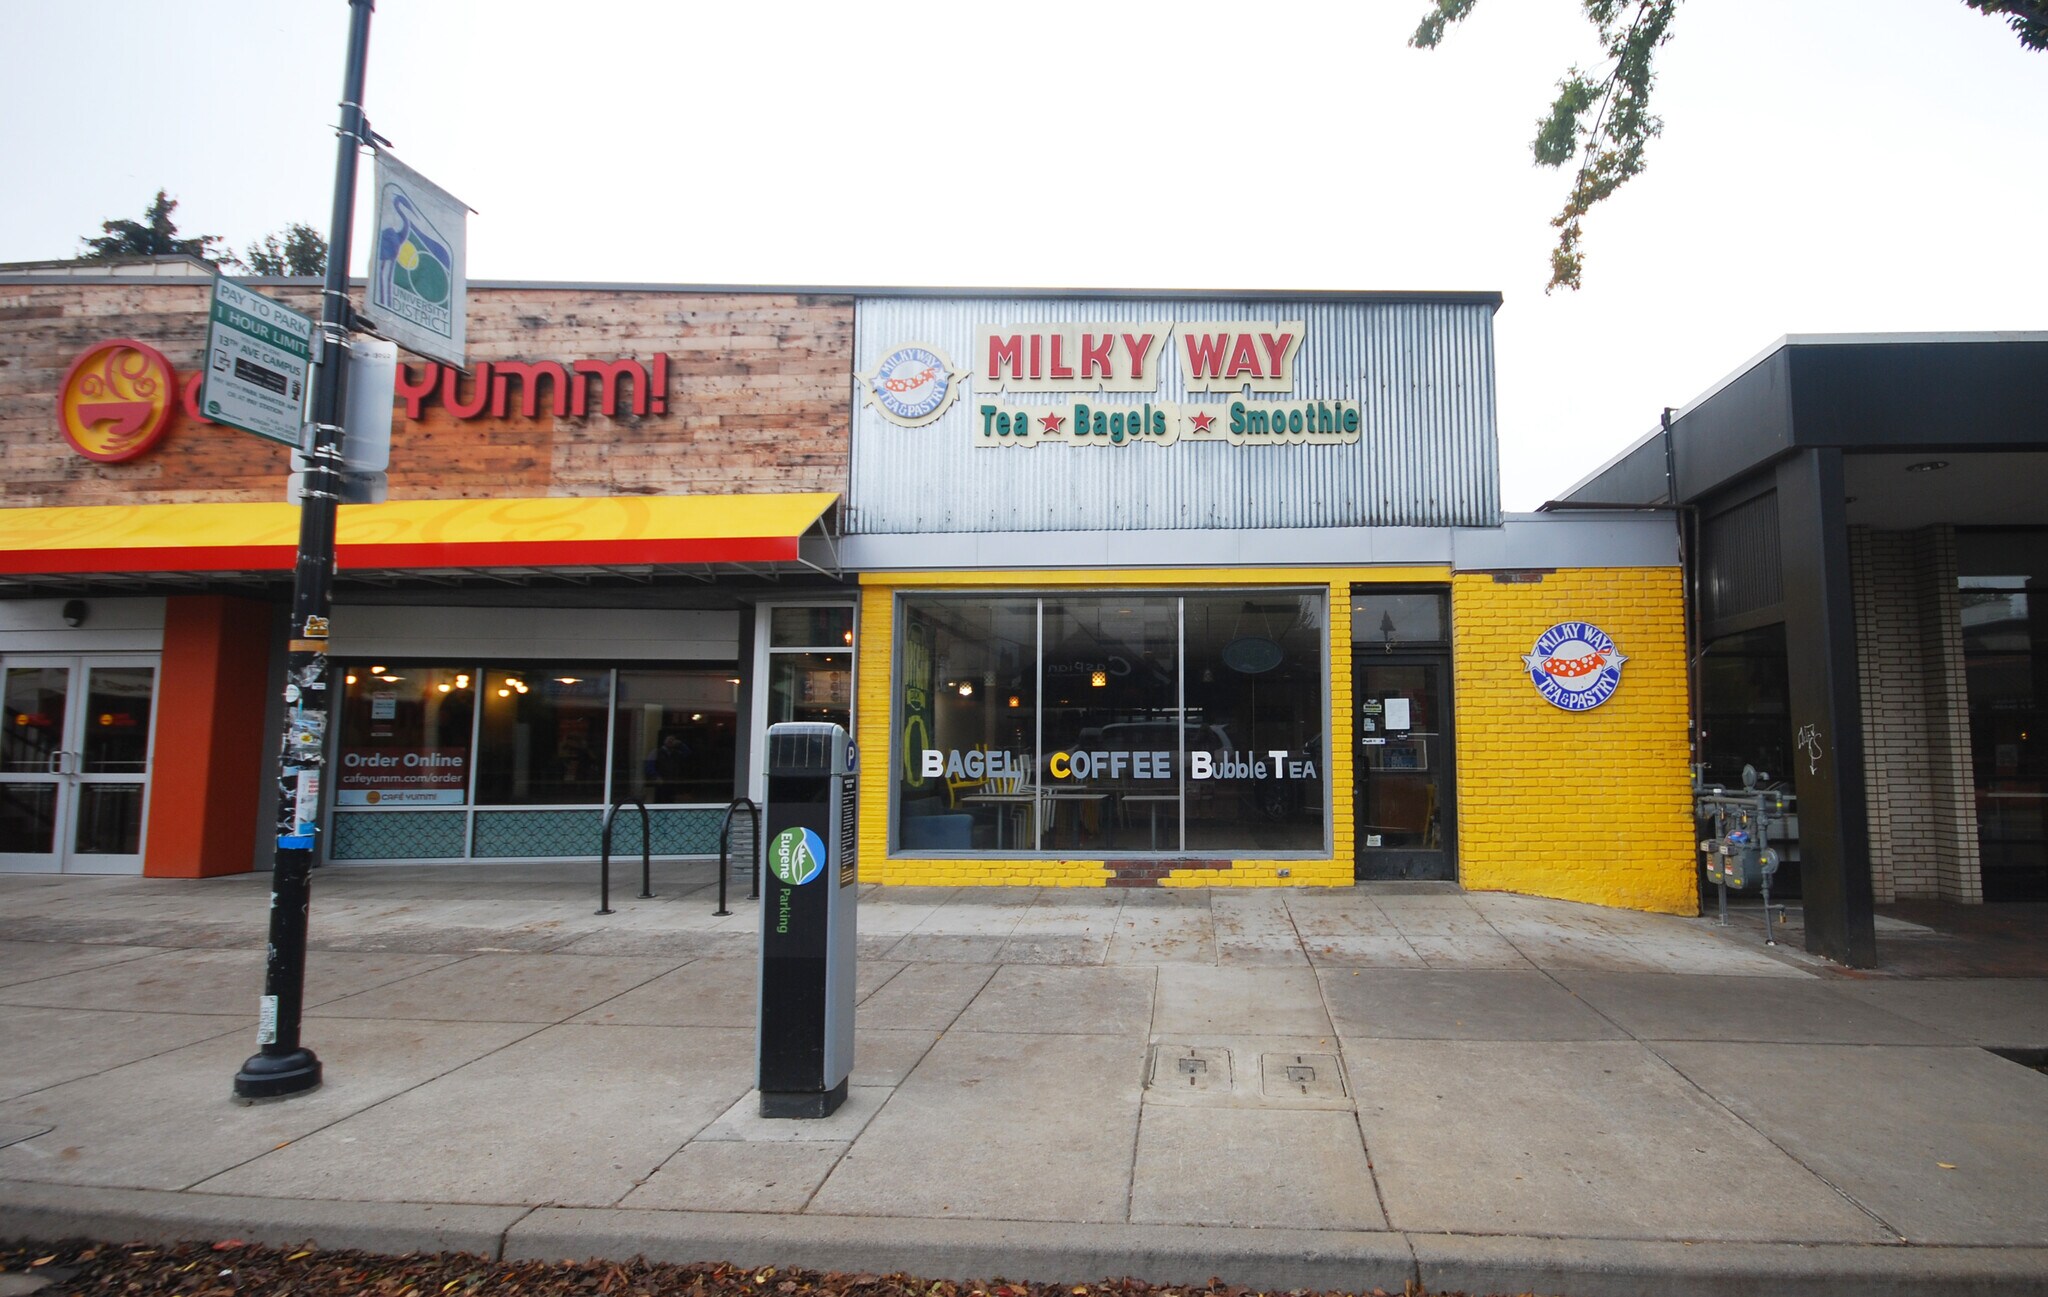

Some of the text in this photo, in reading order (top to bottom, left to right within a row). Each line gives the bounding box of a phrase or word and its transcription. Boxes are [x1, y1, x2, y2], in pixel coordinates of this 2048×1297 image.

[220, 285, 307, 336] PAY TO PARK
[392, 287, 448, 319] UNIVERSITY
[392, 299, 449, 334] DISTRICT
[217, 305, 308, 355] 1 HOUR LIMIT
[240, 345, 260, 360] AVE
[262, 353, 301, 377] CAMPUS
[881, 349, 938, 375] MILKY WAY
[988, 333, 1295, 379] MILKY WAY
[980, 401, 1360, 443] Tea Bagels Smoothie
[1538, 623, 1612, 653] MILKY WAY
[344, 752, 463, 768] Order Online
[921, 749, 1318, 780] BAGEL COFFEE Bubble TEA
[342, 772, 463, 785] cafeyumm.com/order
[777, 833, 794, 880] Eugene
[776, 888, 792, 934] Parking
